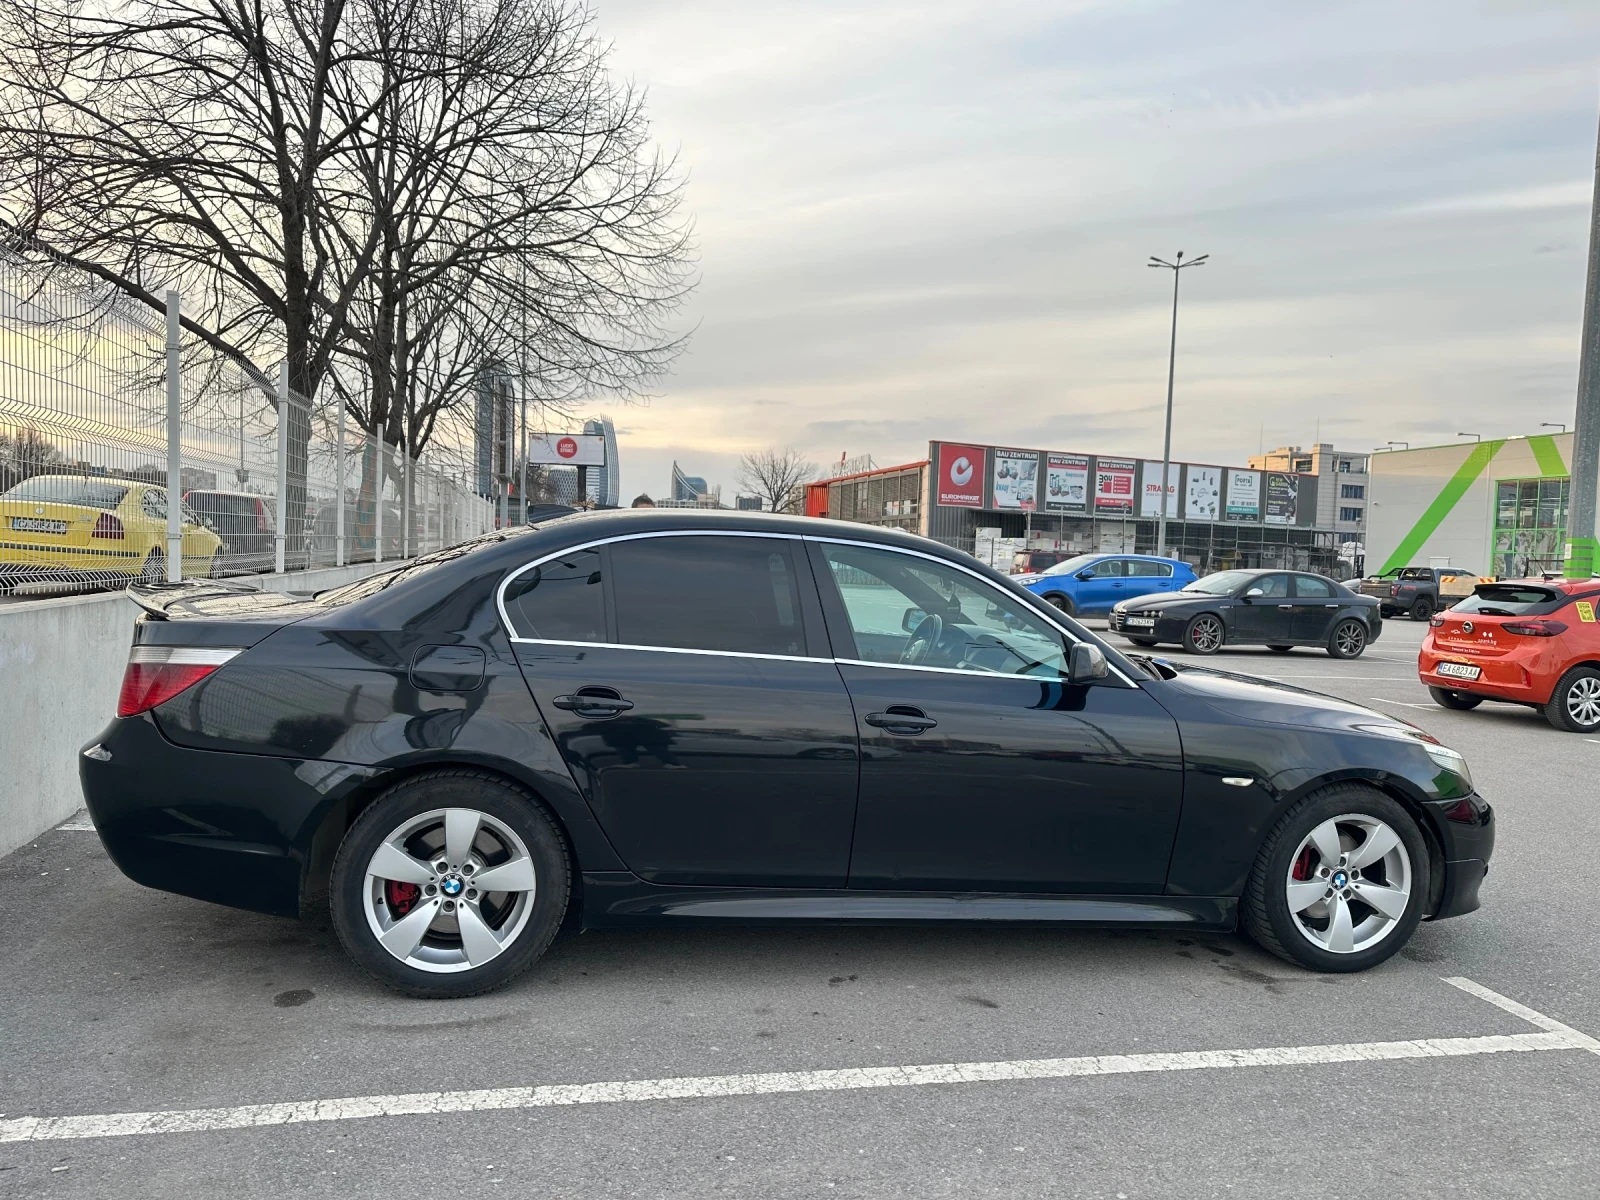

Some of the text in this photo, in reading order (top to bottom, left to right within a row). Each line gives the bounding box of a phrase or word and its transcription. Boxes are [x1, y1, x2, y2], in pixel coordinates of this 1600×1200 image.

[1010, 452, 1038, 460] ZENTRUM
[1146, 484, 1175, 493] STRAAG
[1452, 666, 1468, 676] 6823
[1468, 668, 1477, 676] AA
